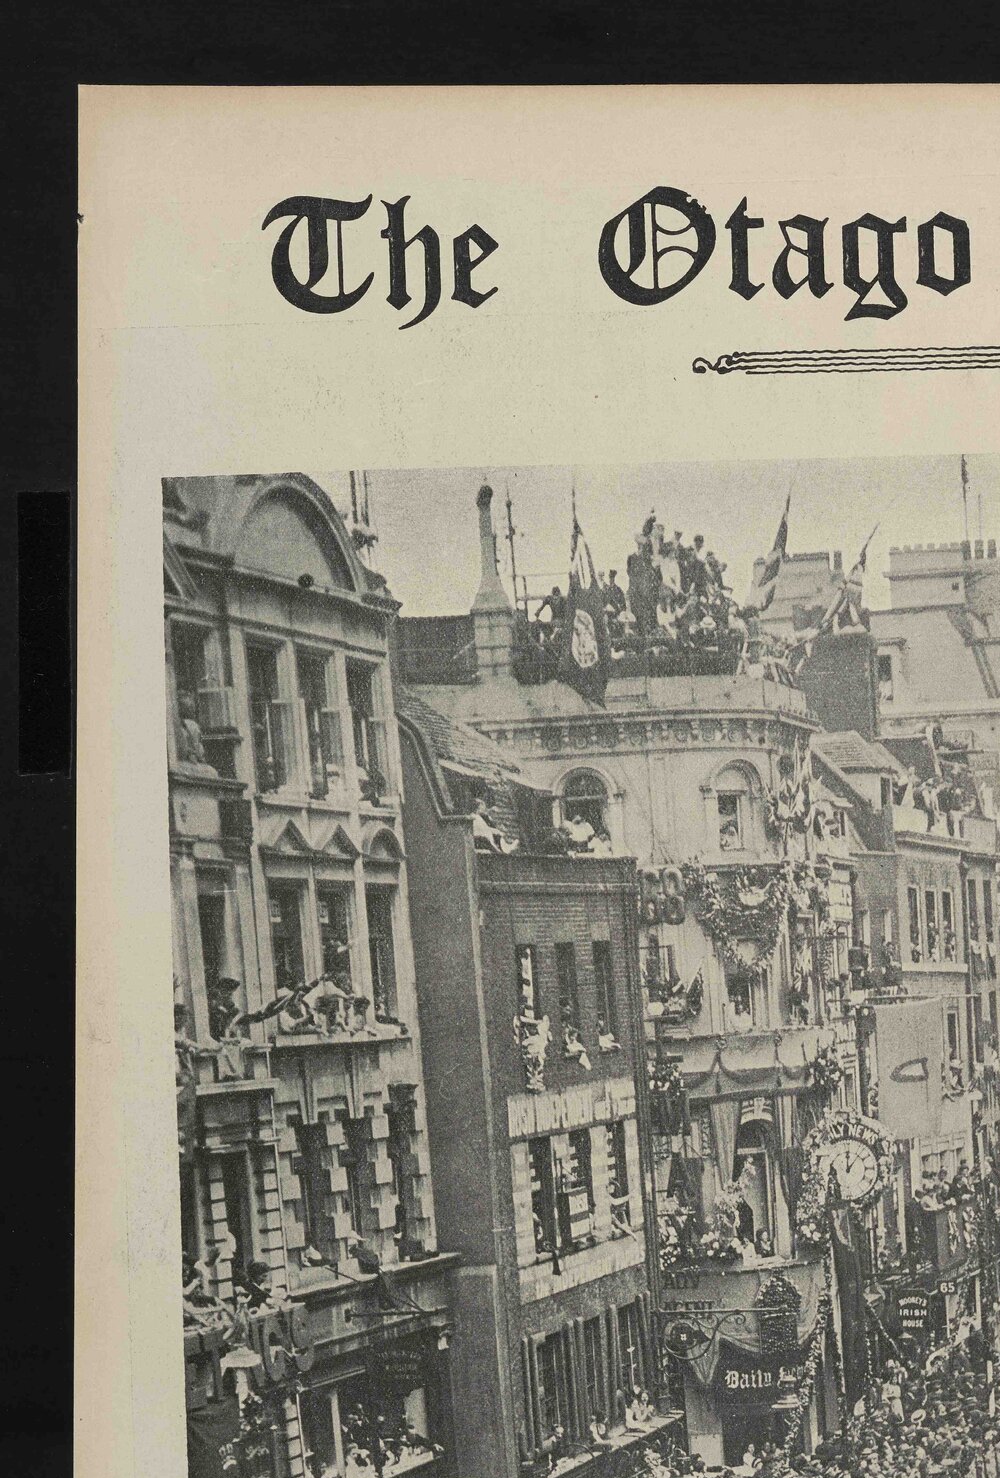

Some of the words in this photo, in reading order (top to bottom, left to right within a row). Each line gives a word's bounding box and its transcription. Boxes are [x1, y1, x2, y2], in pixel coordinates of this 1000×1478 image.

[261, 193, 500, 330] The
[599, 186, 972, 322] Otago
[940, 1282, 955, 1293] 65
[902, 1320, 924, 1328] HOUSE
[725, 1369, 772, 1389] Daily
